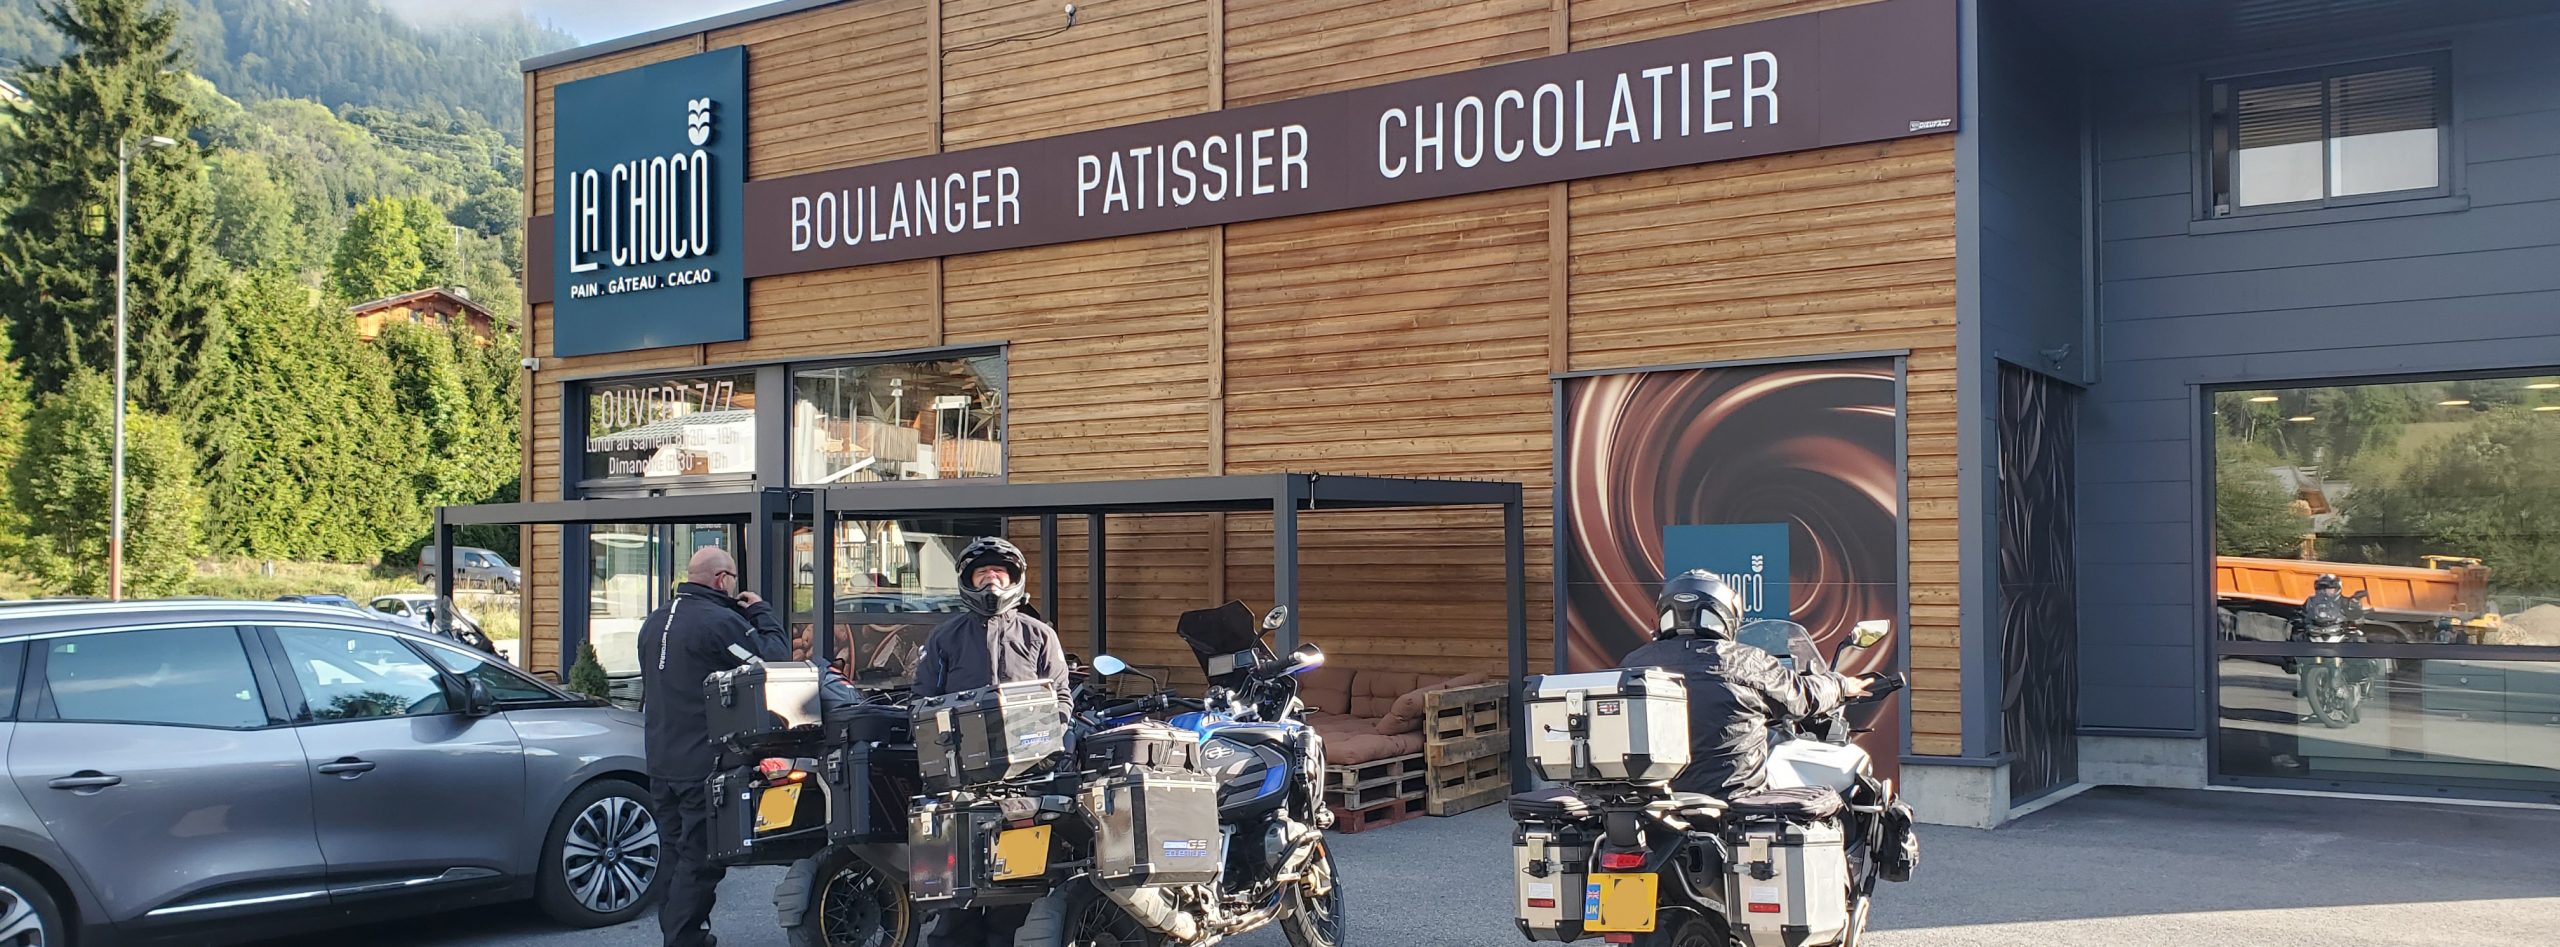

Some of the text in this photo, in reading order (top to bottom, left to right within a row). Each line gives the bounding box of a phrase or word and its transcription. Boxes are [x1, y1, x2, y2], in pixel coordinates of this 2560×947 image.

[790, 50, 1780, 253] BOULANGER PATISSIER CHOCOLATIER
[570, 168, 599, 273] LA
[570, 282, 598, 299] PAIN
[608, 275, 657, 294] GÂTEAU
[668, 268, 711, 287] CACAO
[601, 381, 734, 429] OUVERT 7/7
[586, 435, 615, 453] Lundi
[616, 437, 630, 451] au
[658, 631, 668, 670] MOTORRAD
[1187, 840, 1207, 849] GS
[1586, 905, 1598, 914] UK
